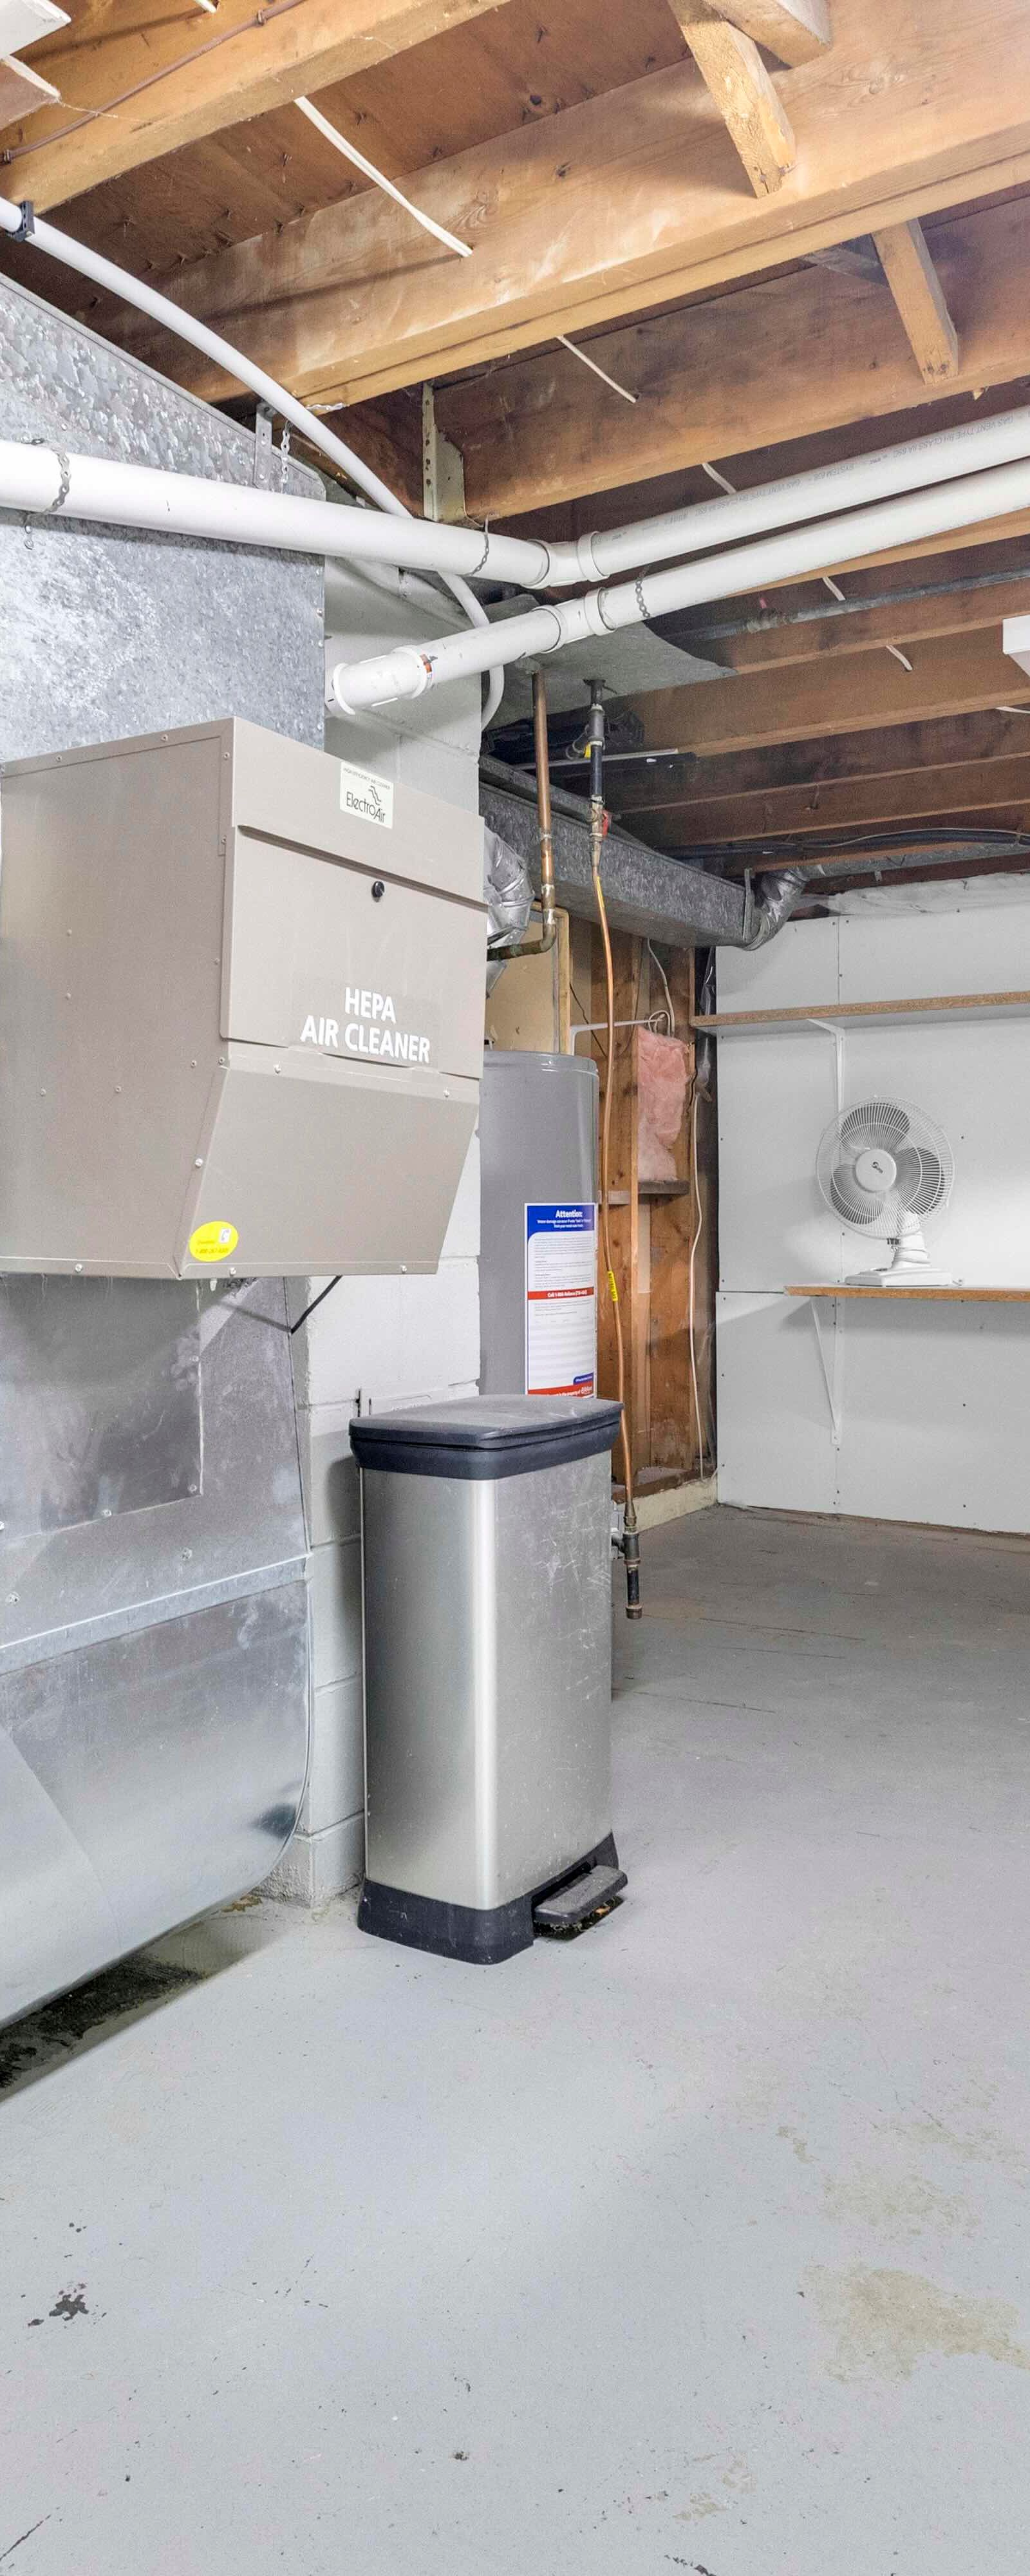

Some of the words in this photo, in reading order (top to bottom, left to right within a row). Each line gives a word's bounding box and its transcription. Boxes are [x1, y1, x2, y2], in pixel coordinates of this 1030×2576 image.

[346, 791, 386, 823] ElectroAir
[344, 987, 397, 1024] HEPA
[299, 1015, 340, 1048] AIR
[344, 1023, 431, 1063] CLEANER
